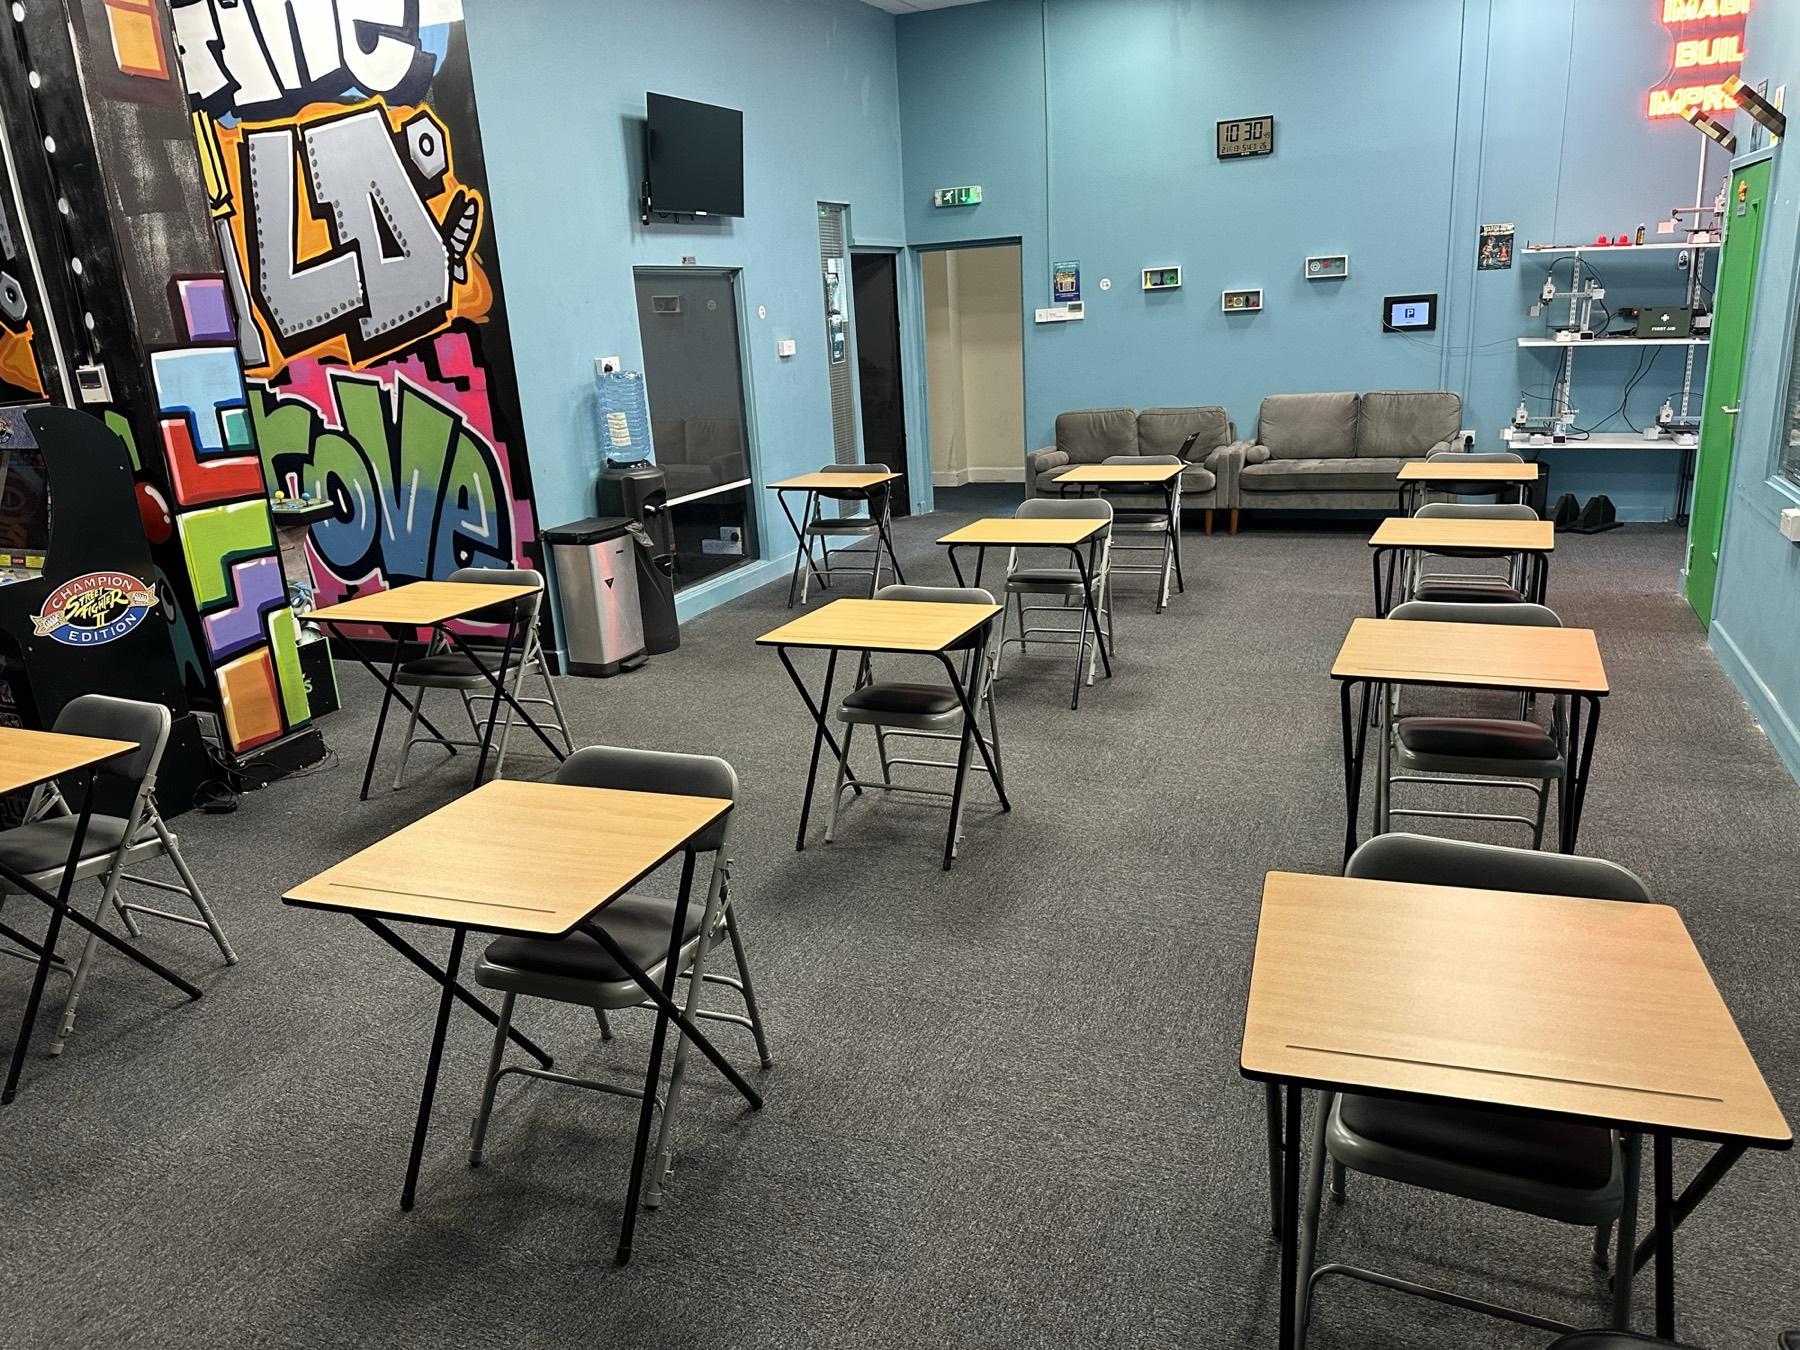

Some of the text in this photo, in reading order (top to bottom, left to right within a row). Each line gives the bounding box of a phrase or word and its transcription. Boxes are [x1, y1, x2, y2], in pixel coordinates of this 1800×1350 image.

[52, 577, 133, 609] CHAMPION
[65, 587, 104, 620] STREET
[74, 588, 129, 619] FIGHTER
[68, 613, 137, 642] EDITION
